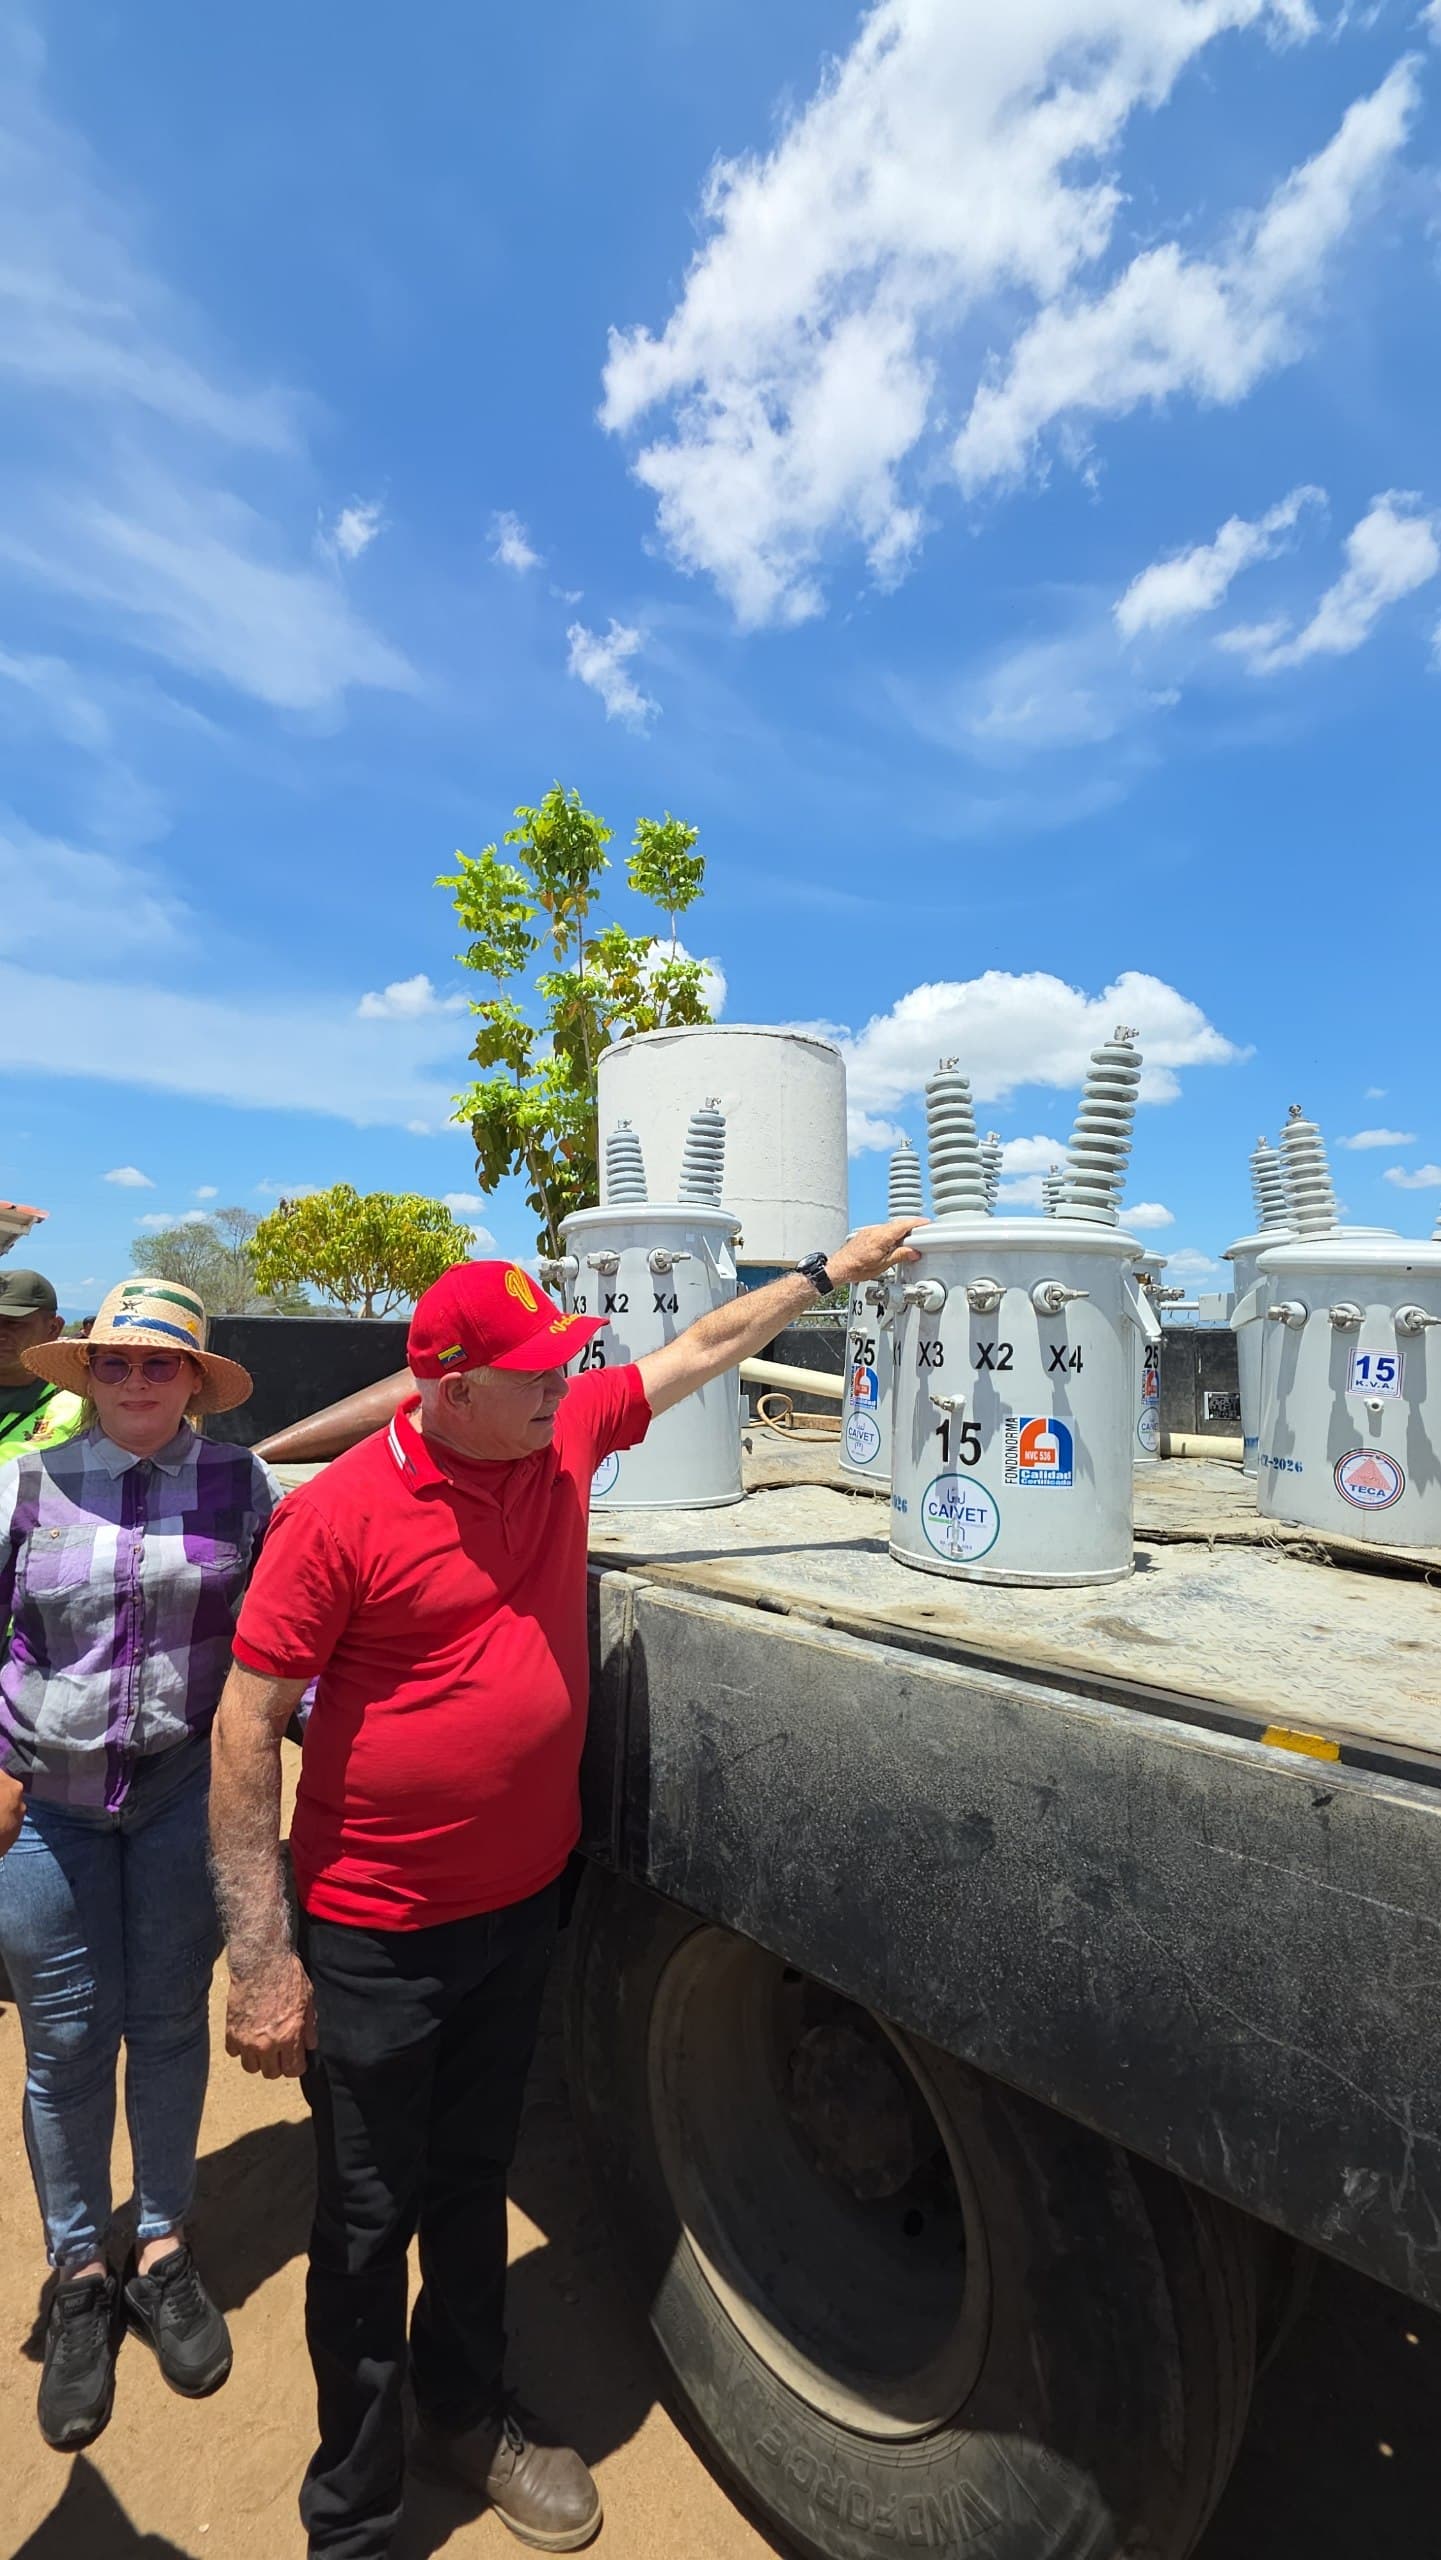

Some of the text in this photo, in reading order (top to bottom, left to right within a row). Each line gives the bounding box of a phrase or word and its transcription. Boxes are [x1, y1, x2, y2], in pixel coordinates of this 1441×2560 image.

[573, 1293, 679, 1314] X3 X2 X4
[852, 1299, 863, 1316] X3
[579, 1340, 606, 1373] 25
[854, 1339, 876, 1367] 25
[919, 1341, 1084, 1373] X3 X2 X4
[1144, 1345, 1159, 1369] 25
[1356, 1355, 1395, 1383] 15
[1355, 1380, 1395, 1390] K.V.A.
[848, 1427, 875, 1443] CAIVET
[935, 1419, 982, 1467] 15
[1005, 1417, 1019, 1485] FONDONORMA
[1025, 1450, 1039, 1461] NVC
[1021, 1470, 1072, 1480] Calidad
[1349, 1484, 1387, 1498] TECA
[928, 1502, 988, 1523] CAIVET
